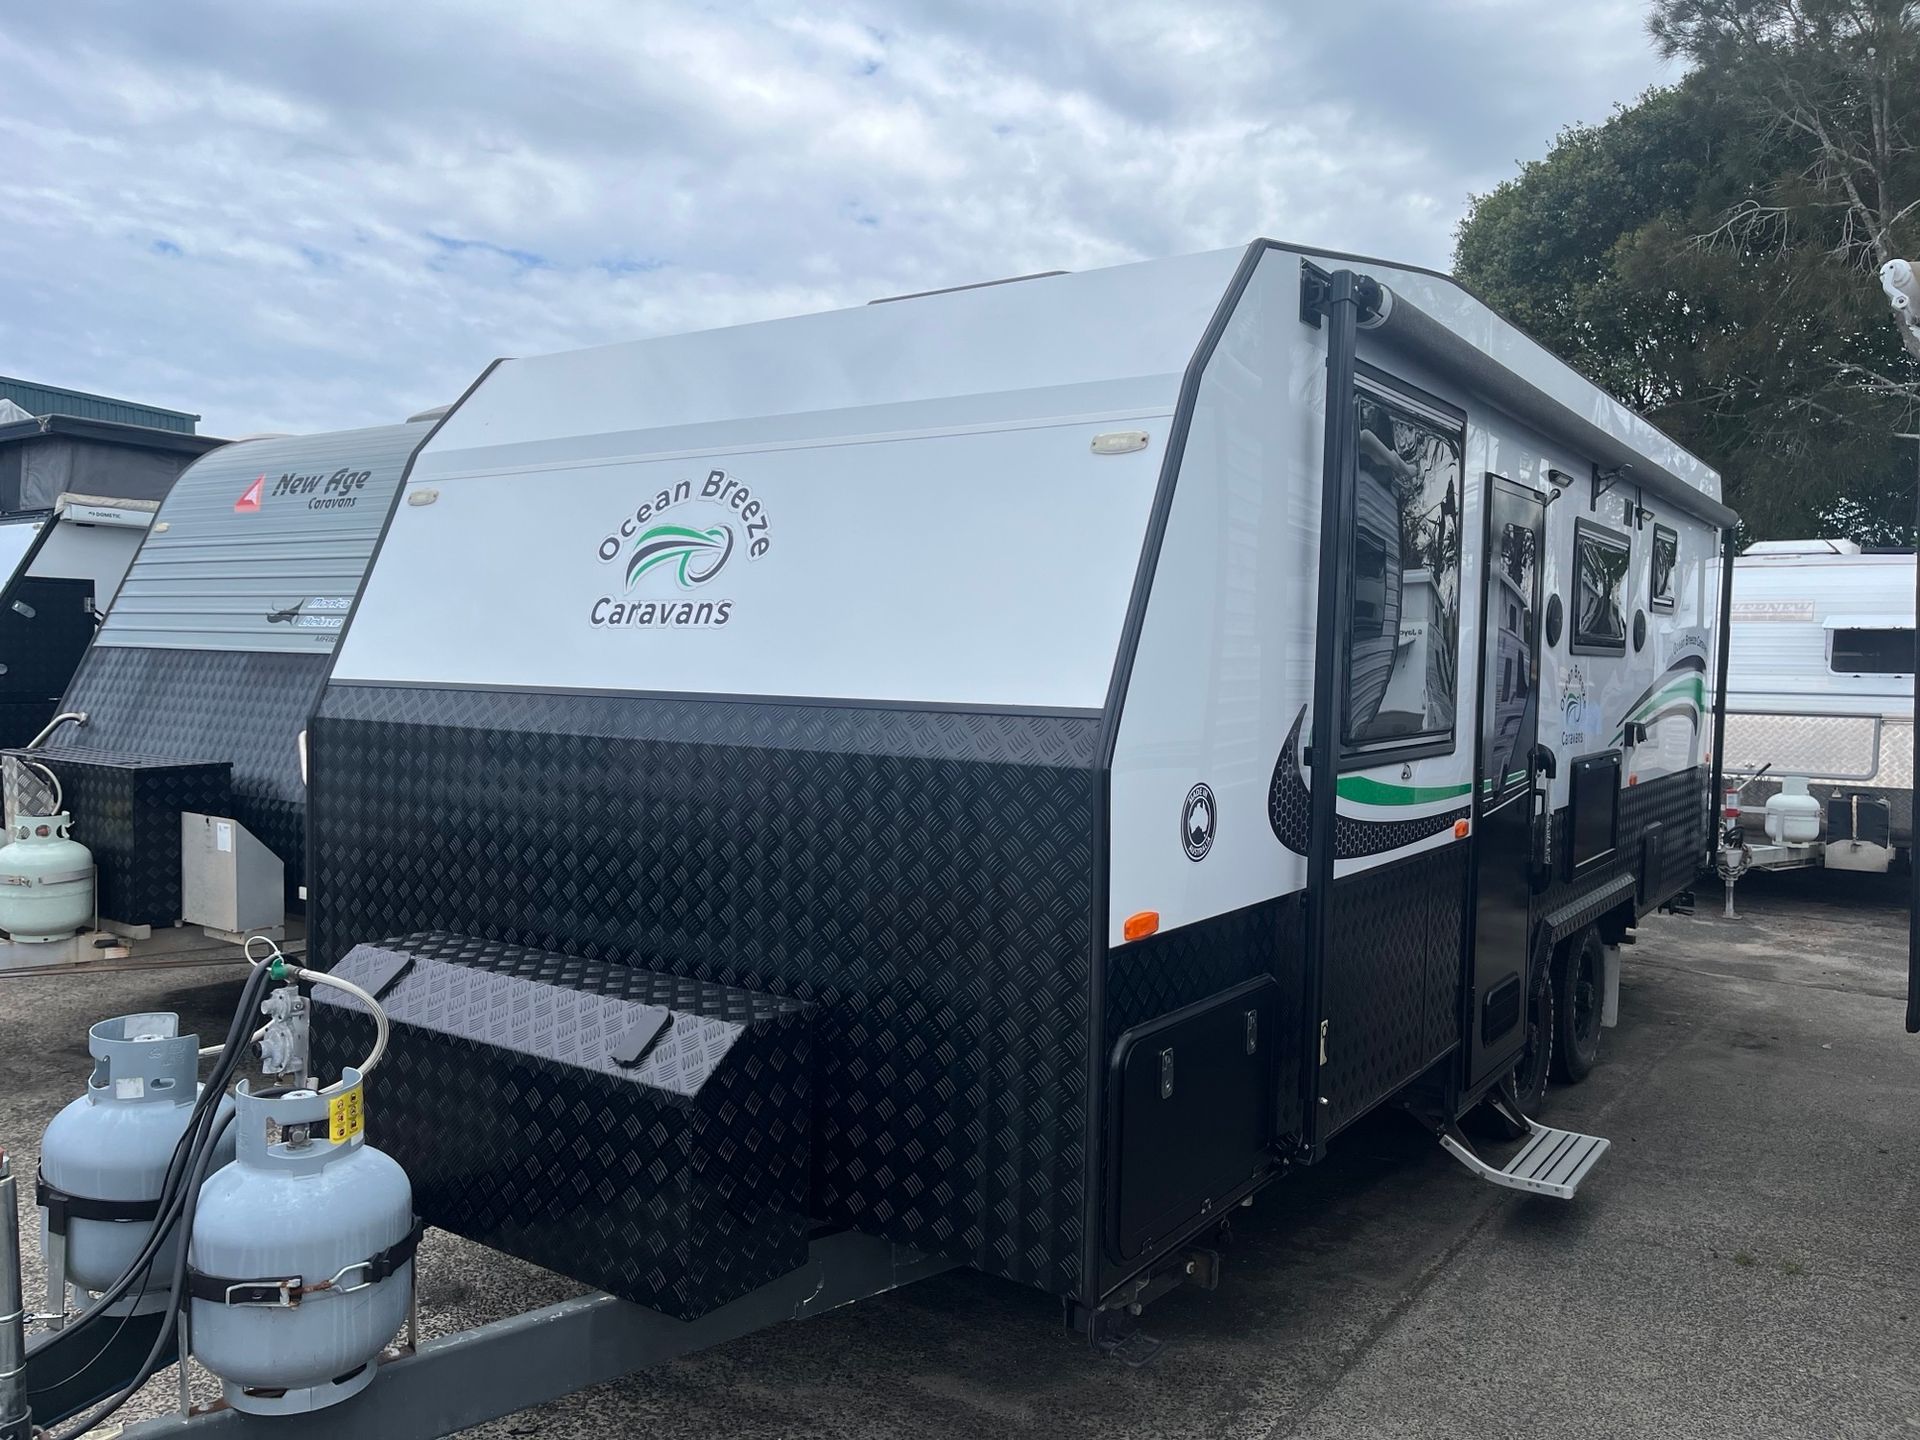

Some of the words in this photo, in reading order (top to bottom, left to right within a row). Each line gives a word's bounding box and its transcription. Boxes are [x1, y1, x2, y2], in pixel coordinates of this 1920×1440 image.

[272, 473, 324, 496] New
[324, 468, 371, 496] Age
[308, 497, 357, 510] Caravans
[95, 511, 121, 519] DOMETIC
[598, 480, 691, 561] Ocean
[701, 470, 770, 558] Breeze
[590, 597, 733, 625] Caravans
[298, 616, 343, 628] Deluxe
[1562, 731, 1584, 746] Caravans
[1188, 787, 1202, 804] MADE
[1202, 788, 1209, 798] IN
[1188, 837, 1211, 856] AUSTRALIA
